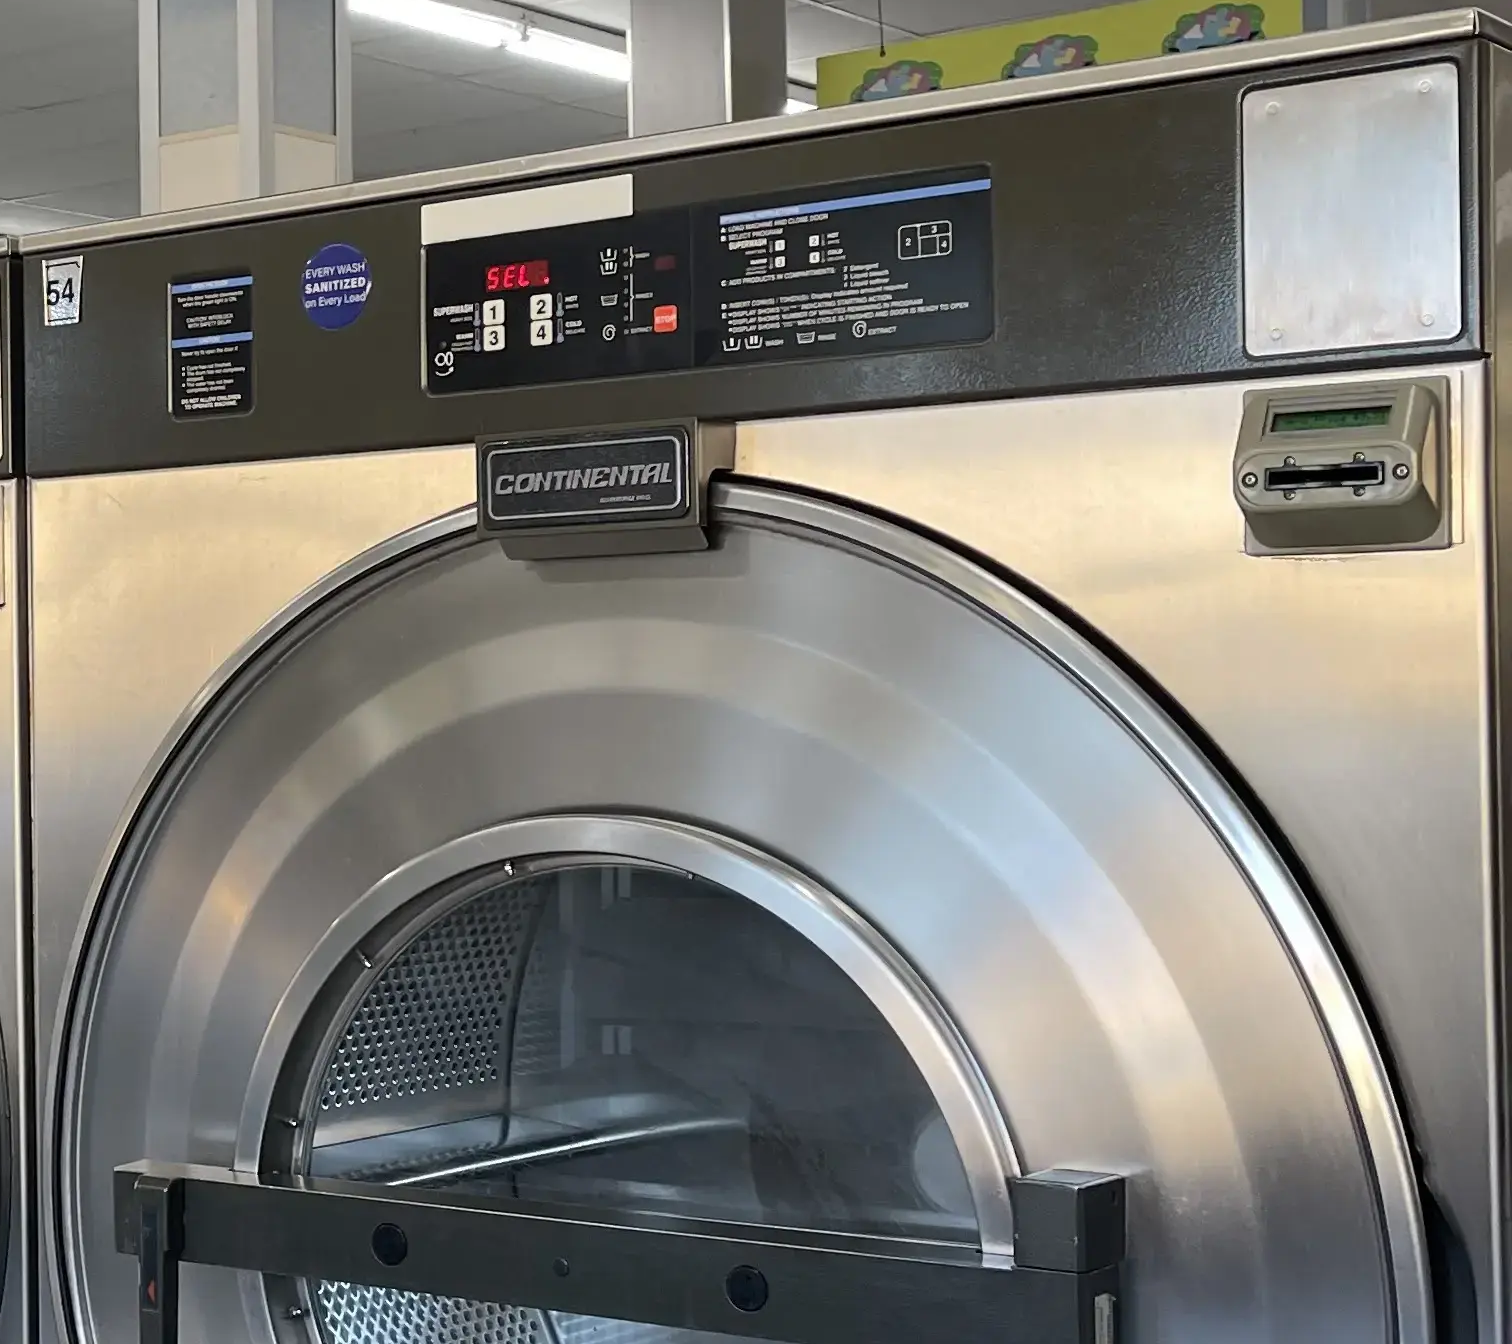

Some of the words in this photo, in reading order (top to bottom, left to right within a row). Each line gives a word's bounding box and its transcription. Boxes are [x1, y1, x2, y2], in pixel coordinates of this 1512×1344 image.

[905, 237, 912, 247] 2
[931, 225, 938, 234] 3
[940, 240, 948, 248] 4
[305, 266, 335, 279] EVERY
[336, 262, 365, 275] WASH
[47, 278, 75, 306] 54
[305, 276, 366, 294] SANITIZED
[305, 300, 316, 308] on
[318, 296, 342, 307] Every
[343, 291, 367, 304] Load
[489, 306, 496, 320] 1
[536, 299, 546, 315] 2
[489, 331, 499, 345] 3
[536, 325, 547, 340] 4
[494, 462, 673, 496] CONTINENTAL
